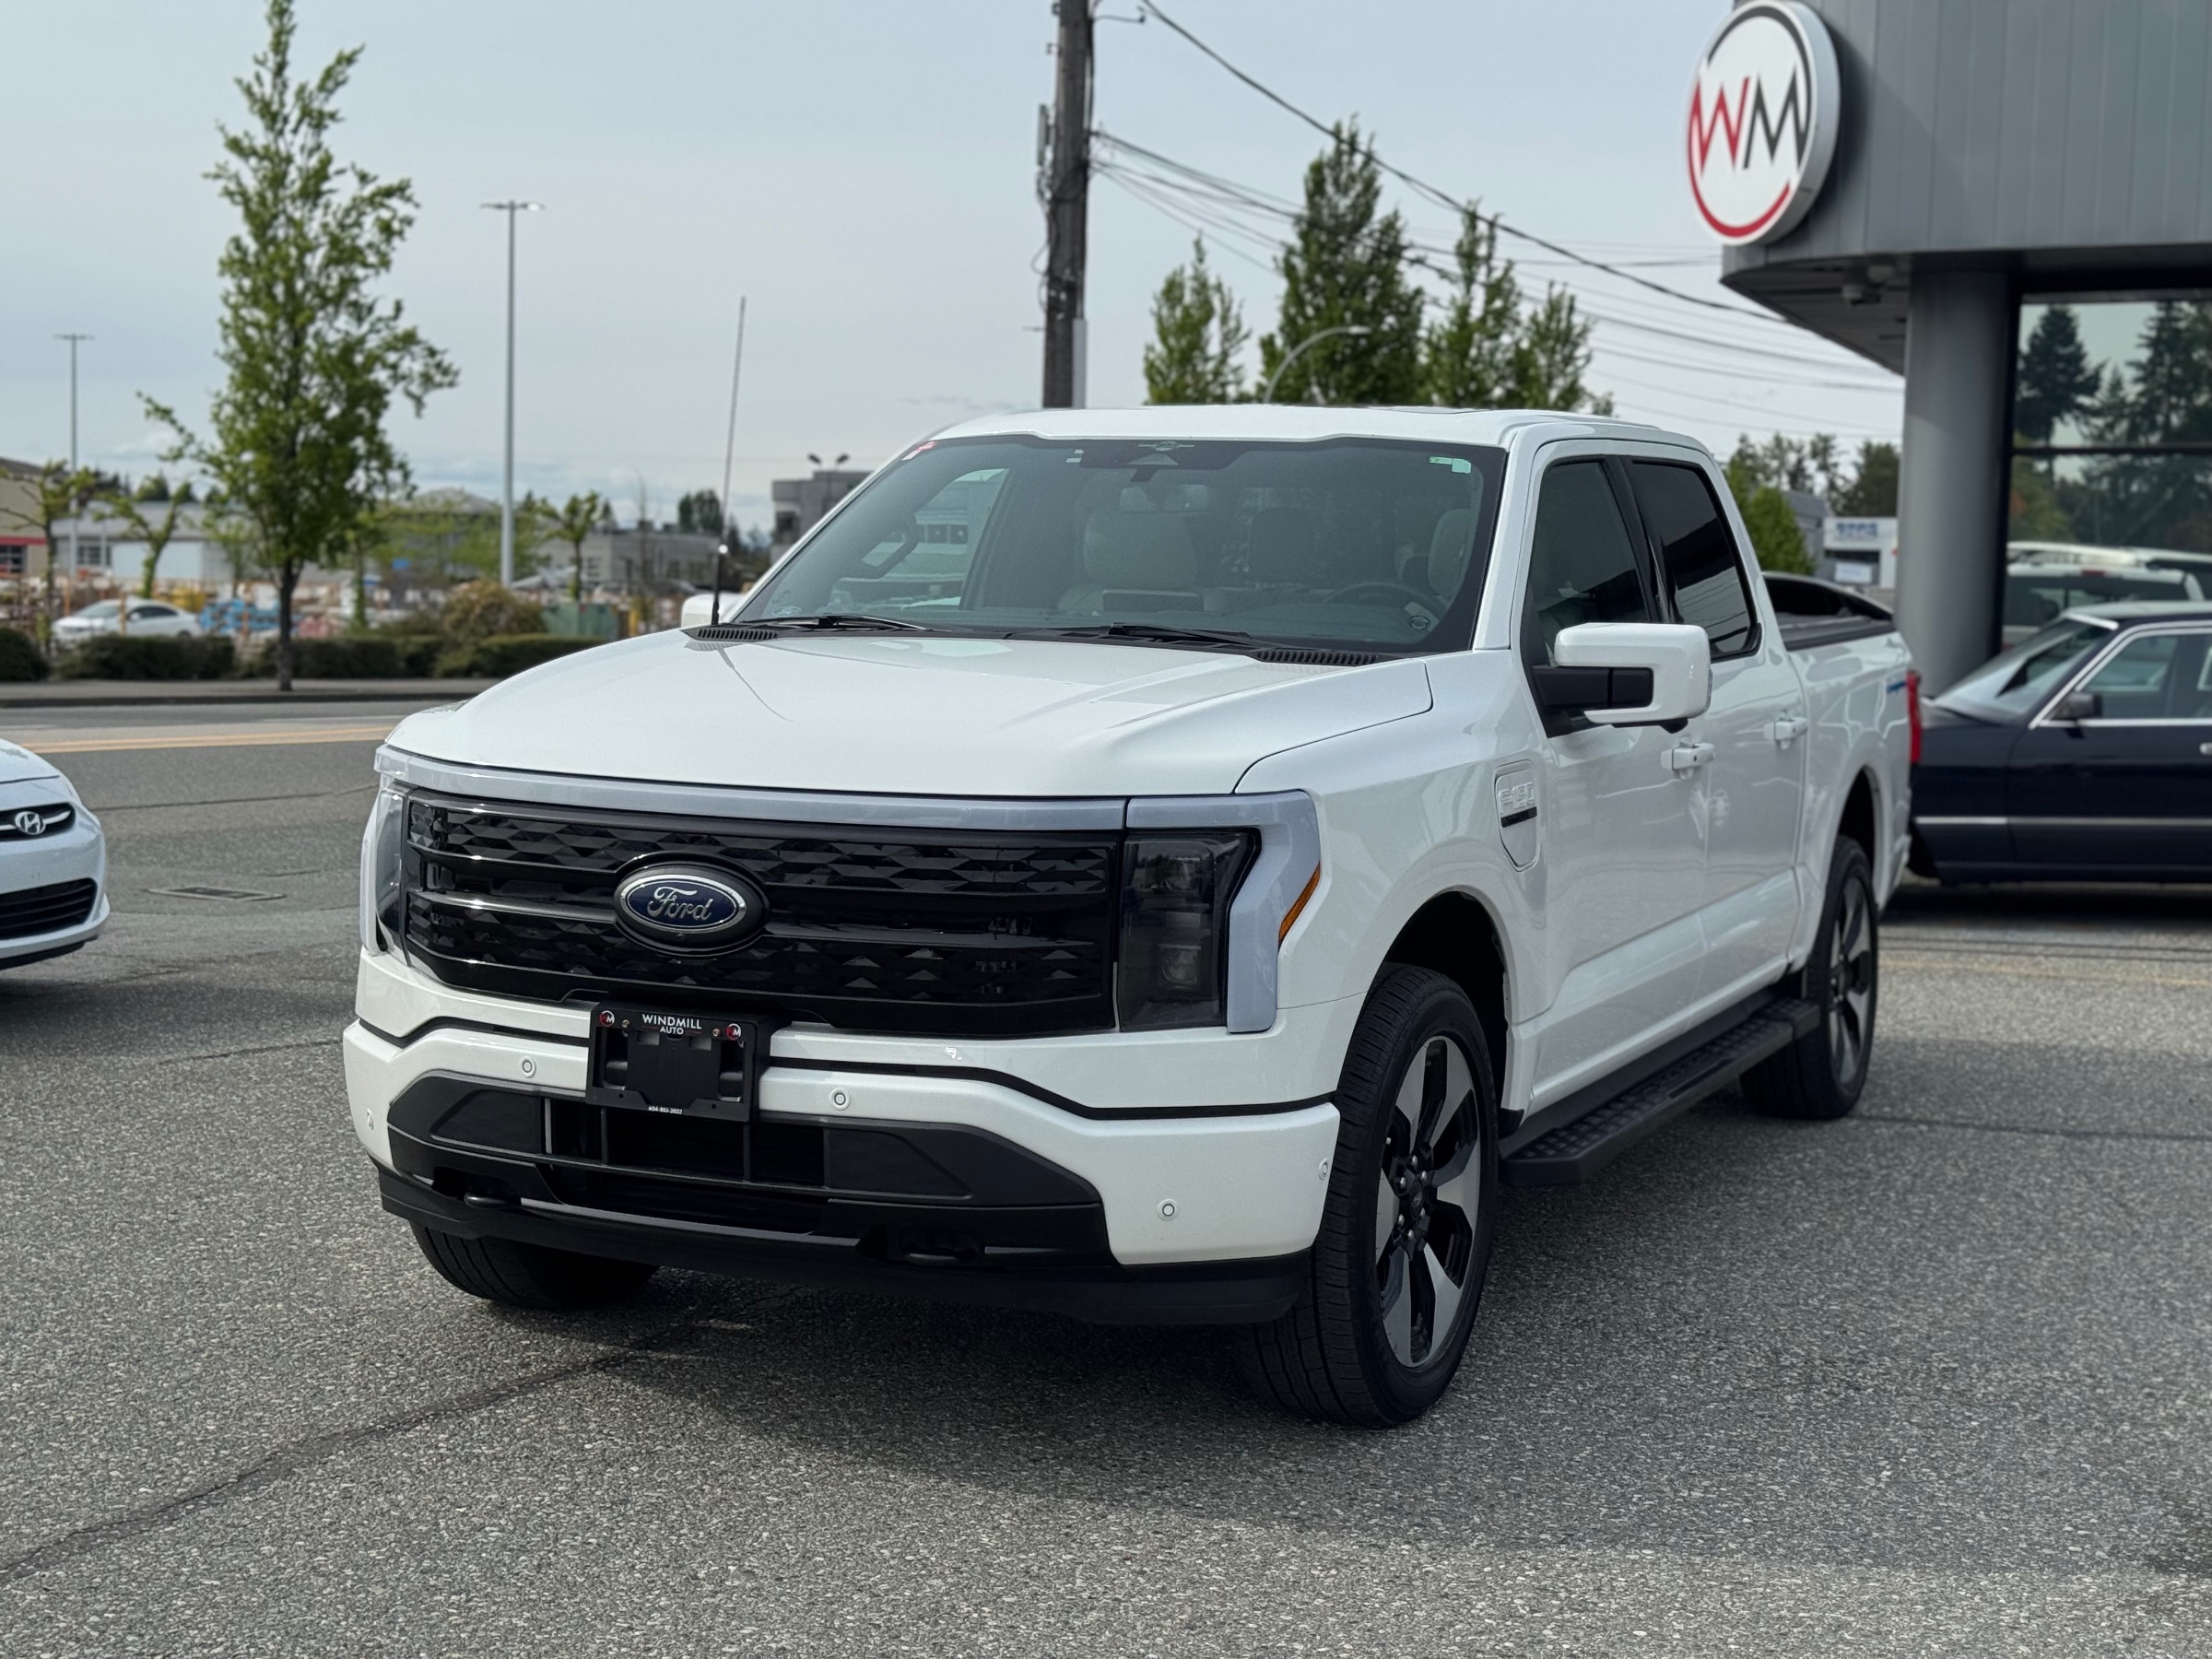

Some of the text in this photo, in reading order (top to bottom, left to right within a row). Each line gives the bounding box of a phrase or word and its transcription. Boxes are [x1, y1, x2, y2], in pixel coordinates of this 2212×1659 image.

[647, 886, 713, 921] Ford
[641, 1014, 702, 1030] WINDMILL
[659, 1026, 685, 1035] AUTO
